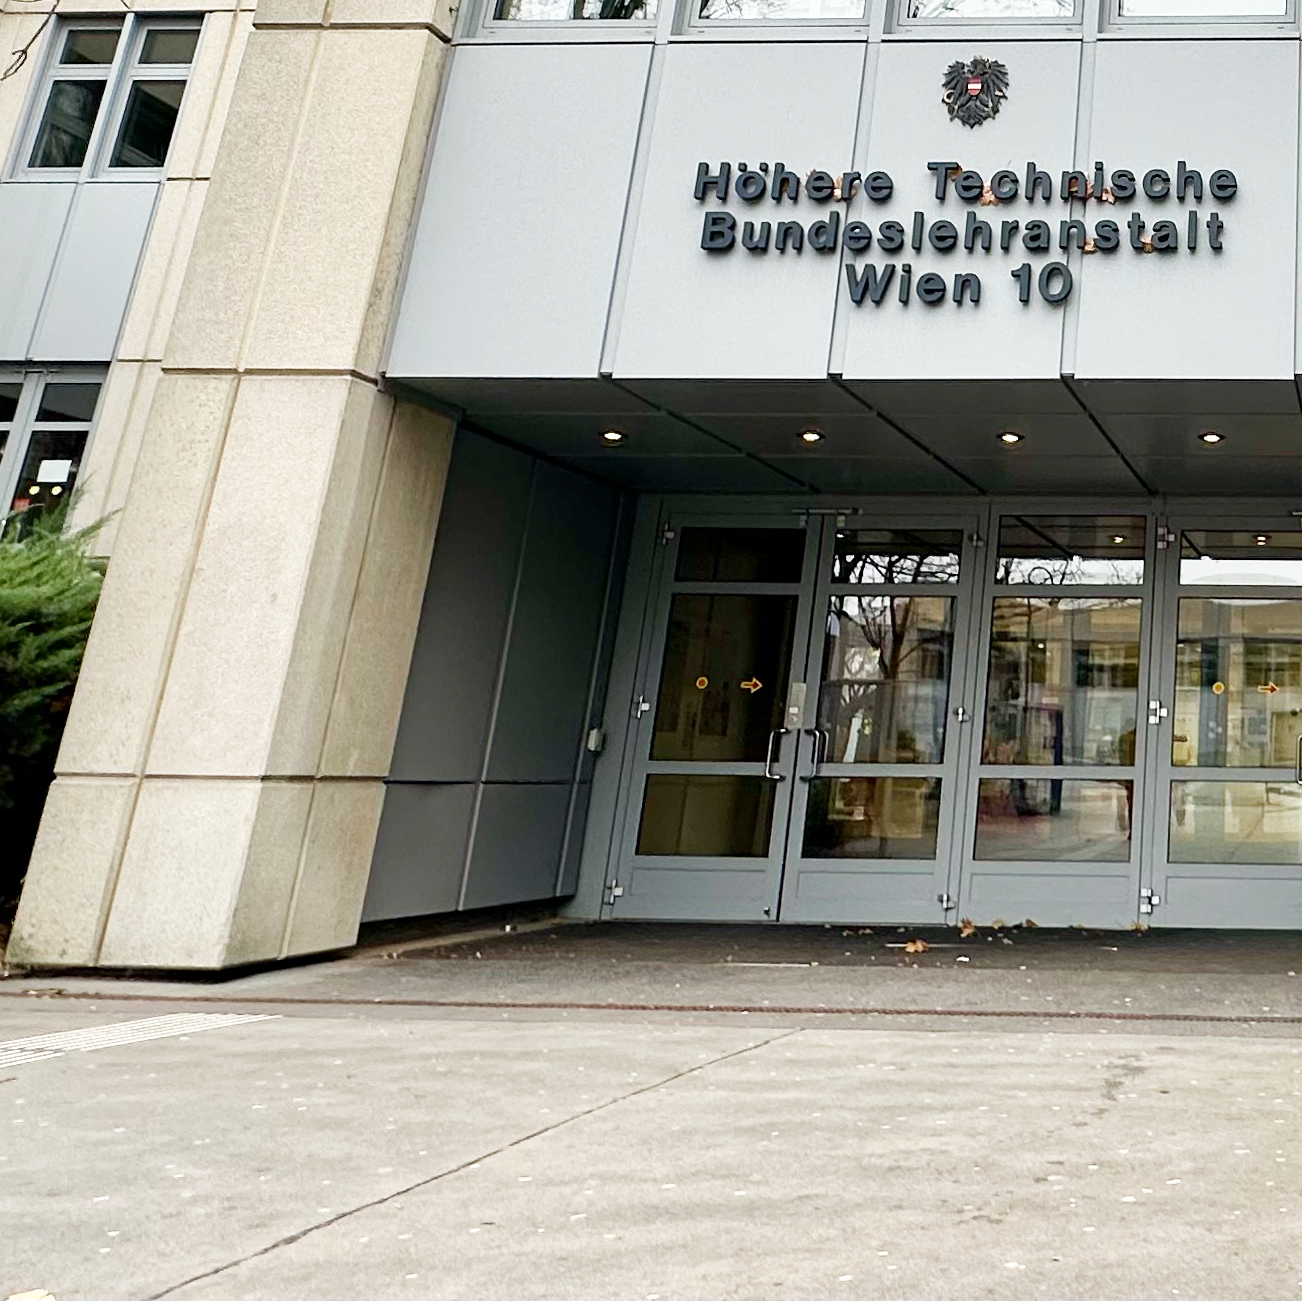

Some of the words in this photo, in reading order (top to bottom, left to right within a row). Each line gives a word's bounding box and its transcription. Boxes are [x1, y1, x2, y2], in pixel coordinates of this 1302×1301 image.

[693, 161, 893, 201] Höhere
[926, 160, 1238, 200] Technische
[700, 210, 1224, 252] Bundeslehranstalt
[845, 262, 982, 305] Wien
[1010, 261, 1074, 304] 10
